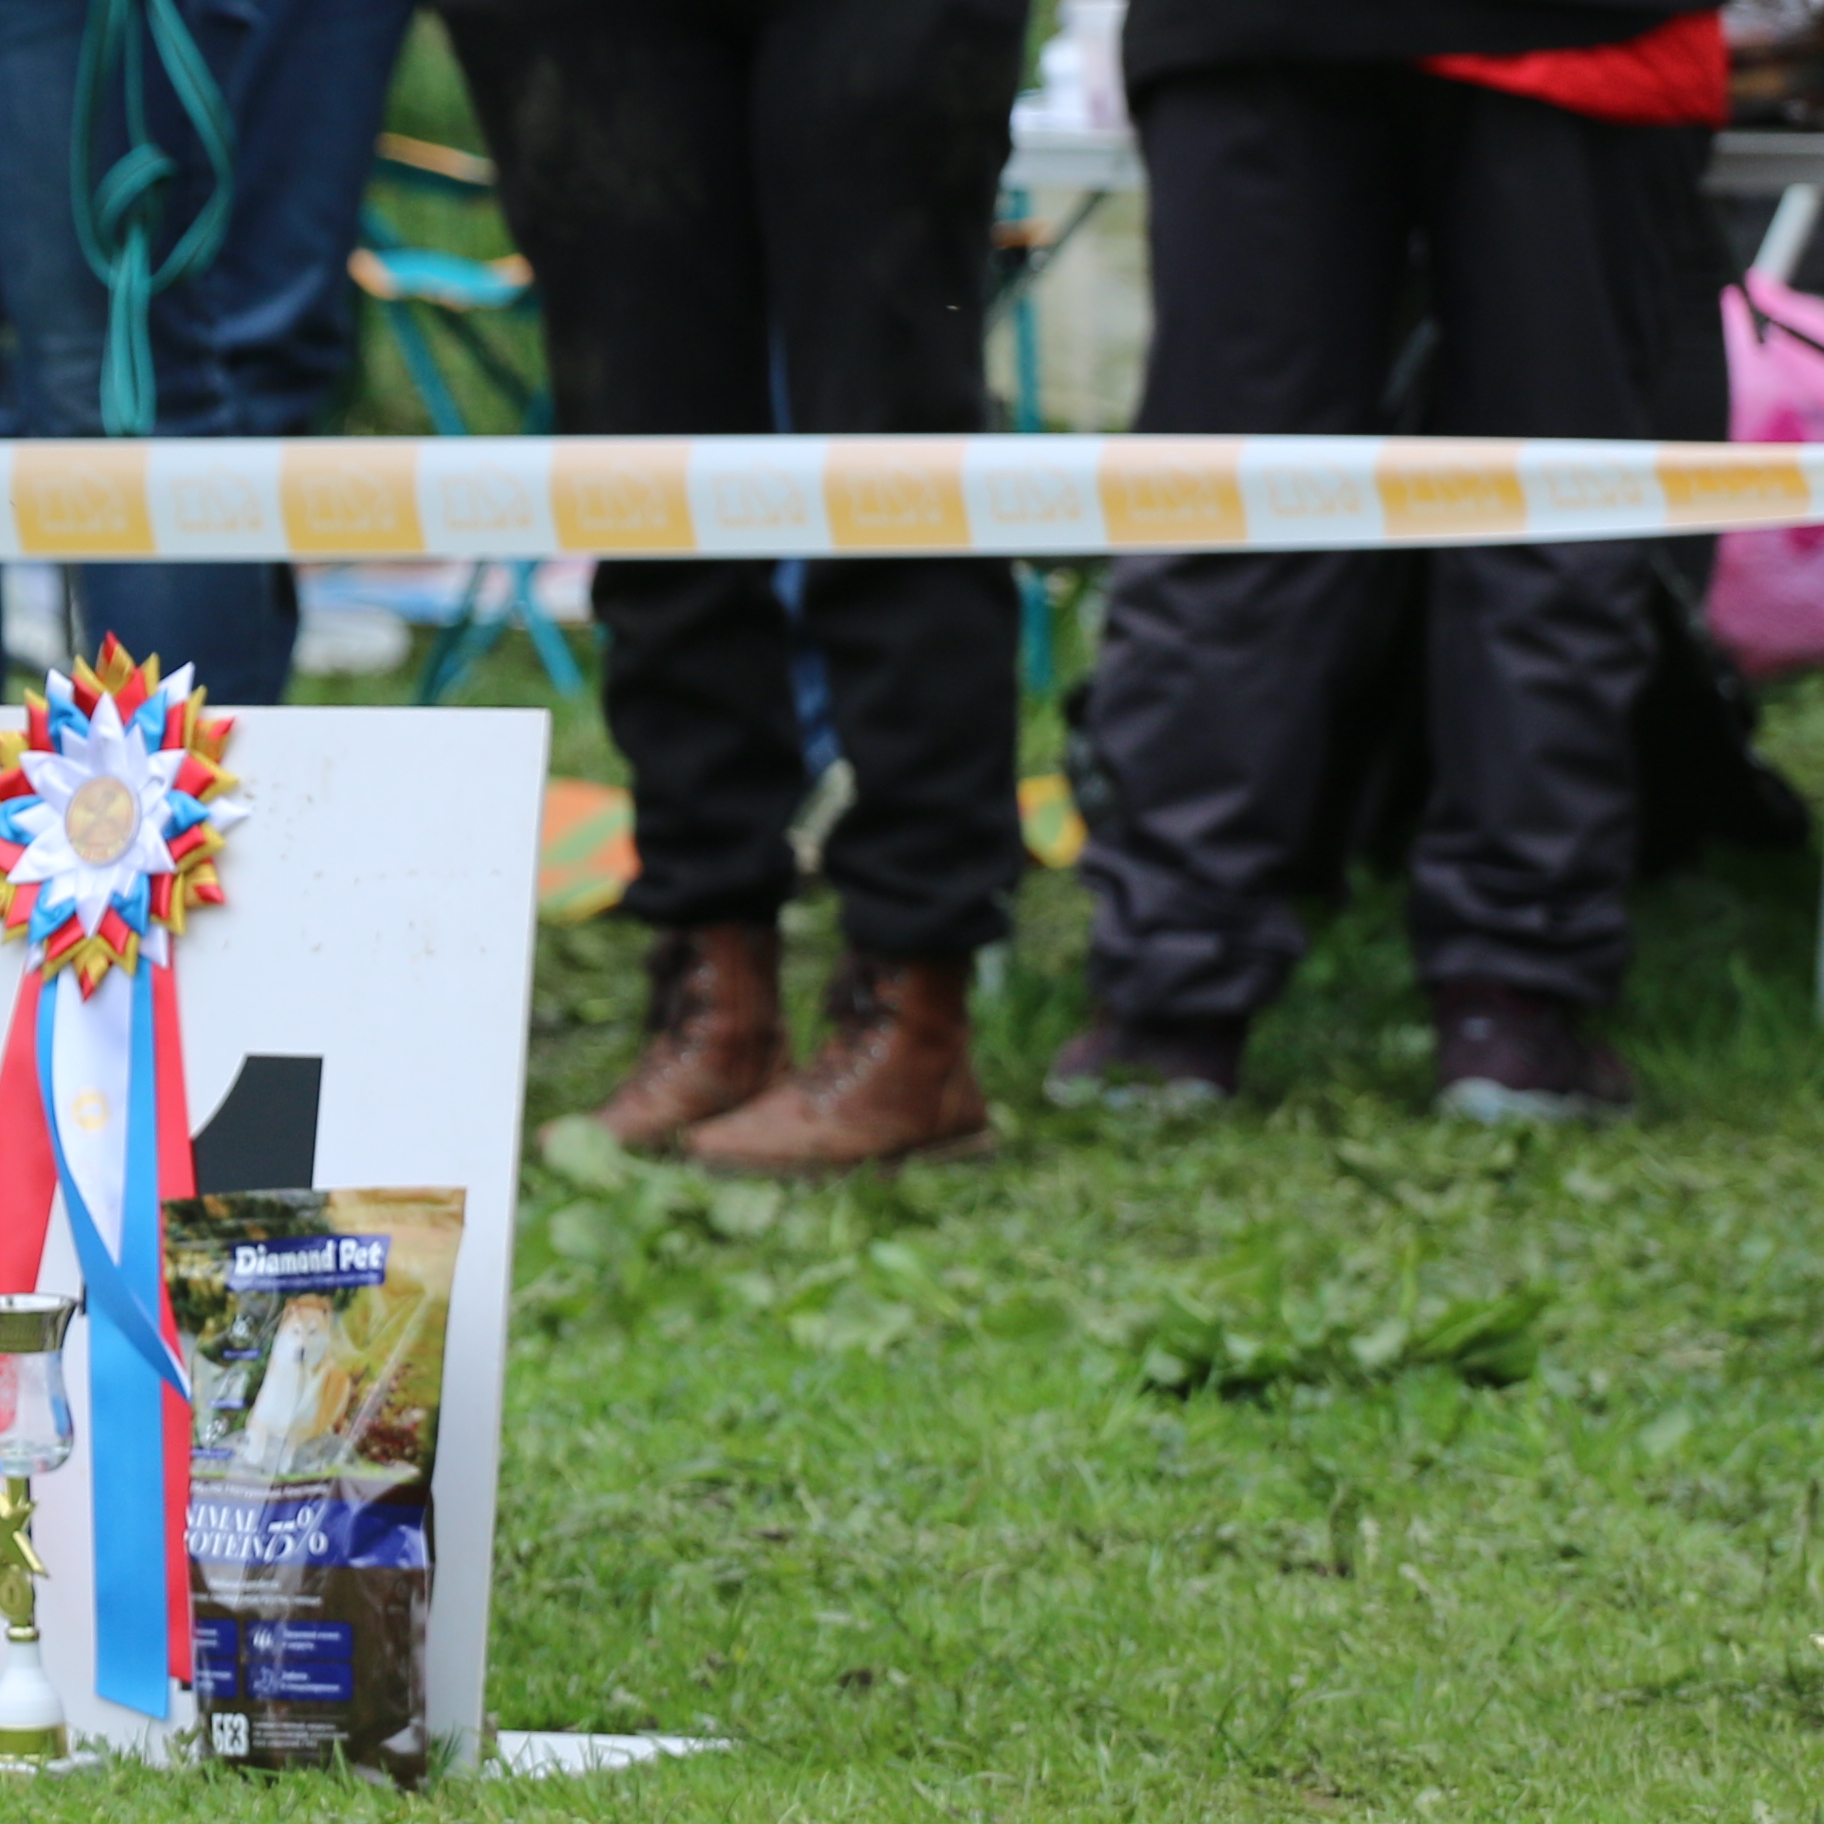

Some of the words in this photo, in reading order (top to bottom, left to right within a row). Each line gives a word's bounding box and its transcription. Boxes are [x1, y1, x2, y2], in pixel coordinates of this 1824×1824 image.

[234, 1239, 337, 1275] Diamond
[338, 1238, 384, 1272] Pet
[185, 1503, 258, 1534] NIMAL
[184, 1530, 265, 1560] OTEIN
